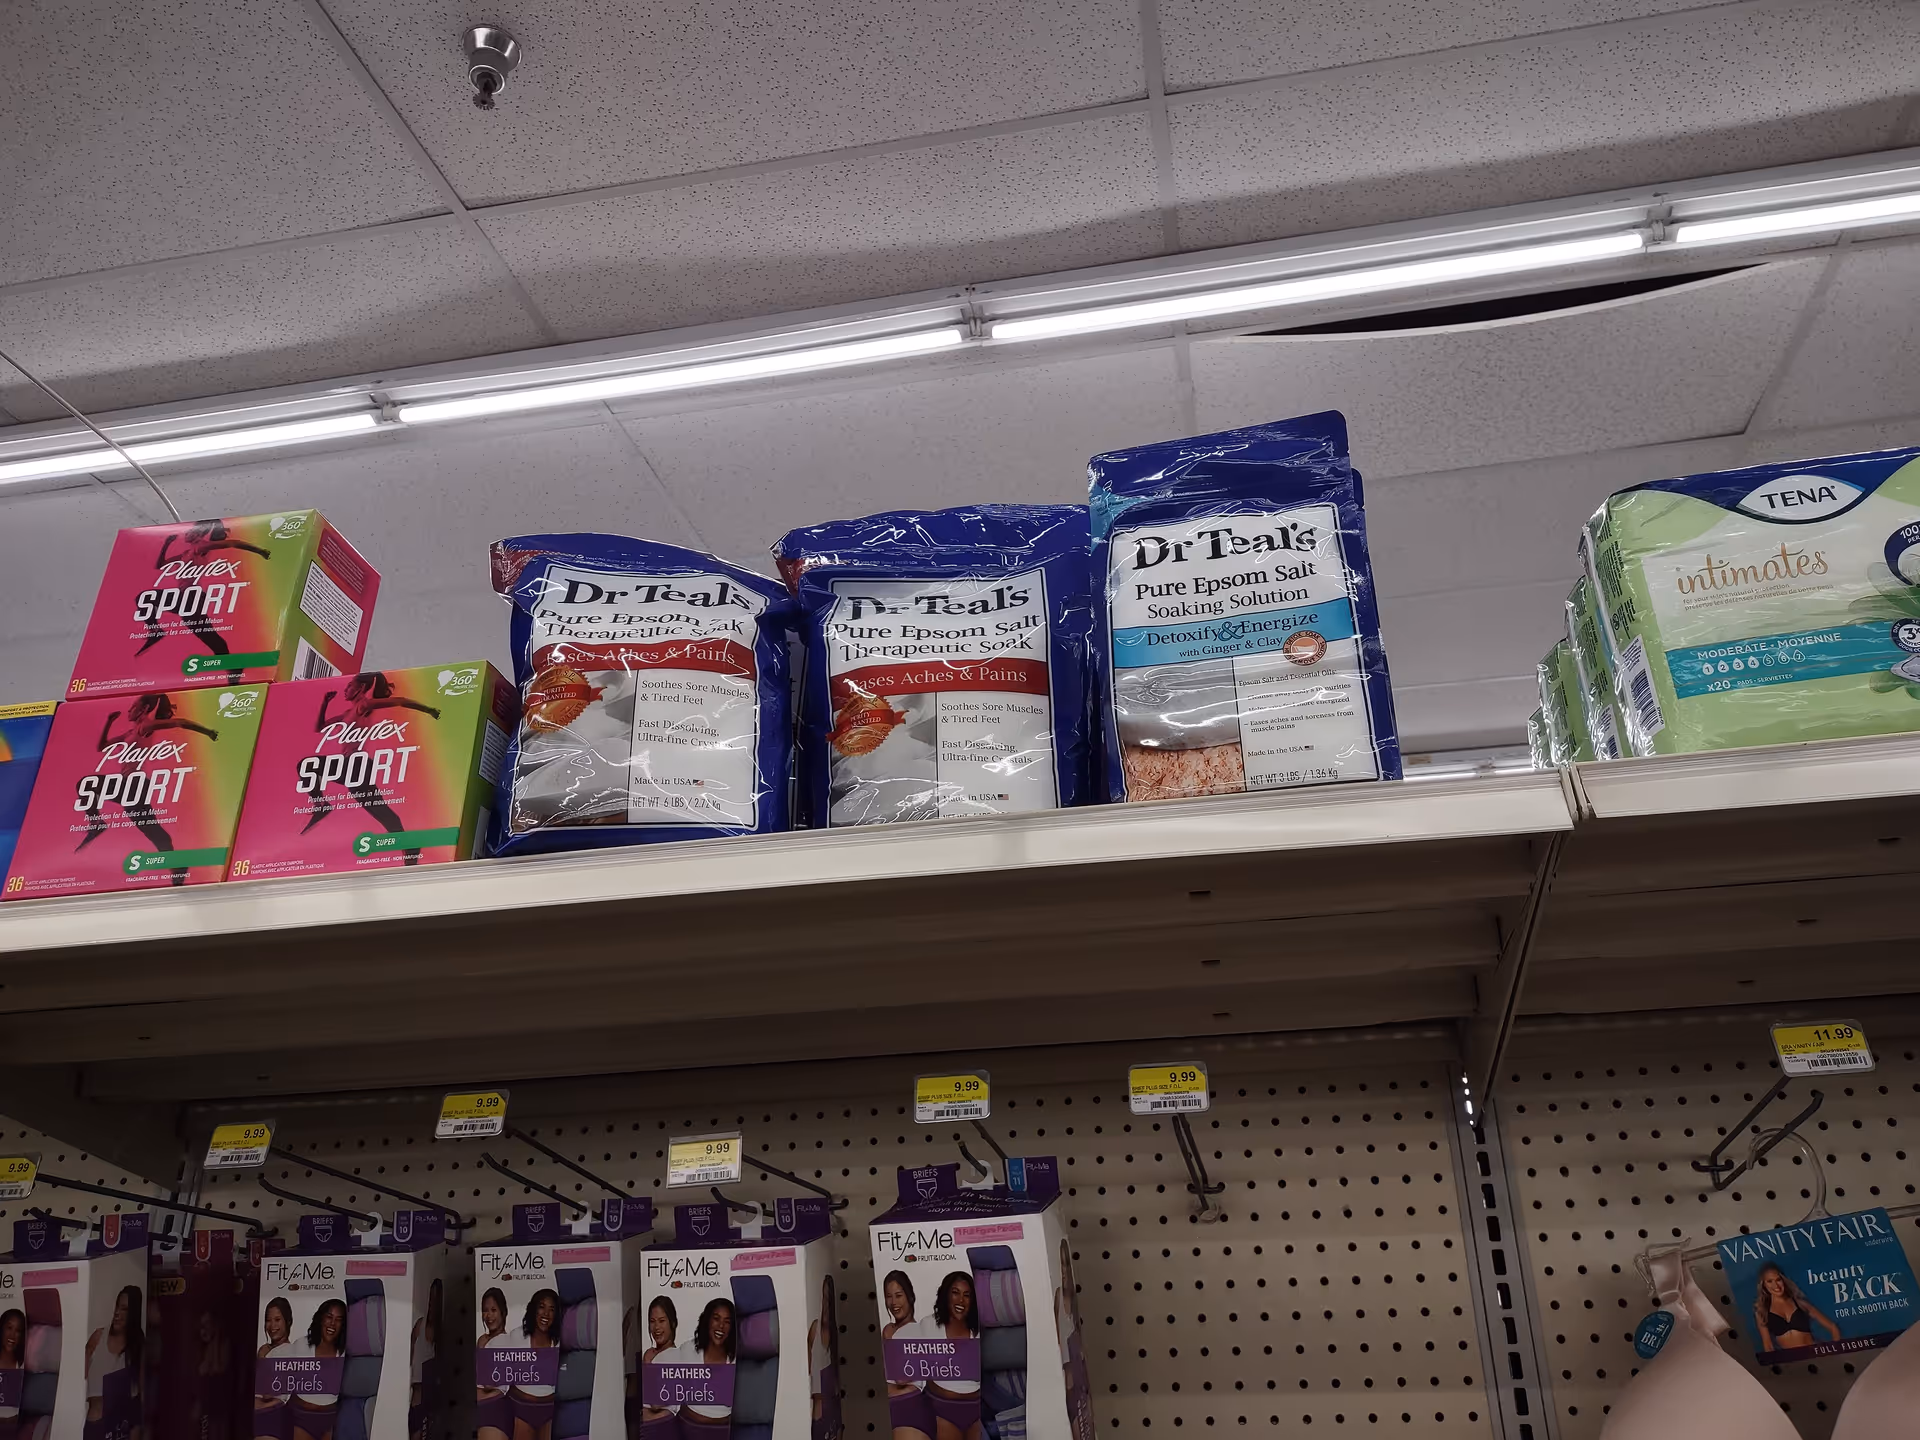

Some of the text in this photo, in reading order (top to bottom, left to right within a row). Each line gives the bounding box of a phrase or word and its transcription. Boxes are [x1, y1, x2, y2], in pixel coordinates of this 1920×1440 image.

[1760, 485, 1838, 510] TENA
[1131, 522, 1318, 570] Dr Teal's
[153, 558, 241, 587] Playtex
[1676, 542, 1829, 594] intimates
[1135, 560, 1317, 600] Pure Epsom Salt
[133, 582, 248, 622] SPORT
[558, 578, 751, 610] Dr Teal's
[846, 585, 1030, 621] Dr Teal's
[1147, 588, 1310, 619] Soaking Solution
[537, 608, 701, 627] Pure Epsom
[544, 619, 744, 641] Therapeutic Soak
[833, 614, 1040, 641] Pure Epsom Salt
[1147, 613, 1319, 646] Detoxify & Energize
[840, 634, 1033, 662] Therapeutic Soak
[1179, 636, 1283, 658] with Ginger & Clay
[1698, 633, 1842, 659] MODERATE MOYENNE
[605, 645, 735, 664] Aches & Pains
[187, 658, 221, 672] S SUPER
[901, 667, 1027, 685] Aches & Pains
[1262, 675, 1275, 684] Salt
[1276, 673, 1289, 682] and
[1707, 674, 1793, 692] x20 SERVIETTES
[71, 679, 87, 692] 36
[543, 686, 566, 694] PURITY
[642, 680, 750, 699] Soothes Sore Muscles
[640, 693, 704, 705] & Tired Feet
[941, 703, 1044, 714] Soothes Sore Muscles
[1337, 710, 1354, 718] from
[951, 715, 978, 723] Tired
[980, 715, 1001, 724] Feet
[638, 720, 720, 737] Fast Dissolving,
[1251, 723, 1296, 733] muscle pains
[315, 719, 409, 754] Playtex
[638, 732, 687, 745] Ultra-fine
[942, 740, 961, 748] Fast
[95, 740, 188, 772] Playtex
[942, 753, 989, 762] Ultra-fine
[296, 746, 417, 793] SPORT
[1250, 768, 1339, 785] NET WT 3 LBS Kg
[74, 766, 193, 811] SPORT
[634, 777, 693, 785] Made USA
[307, 794, 336, 804] Protection
[346, 791, 366, 799] Bodies
[373, 788, 394, 796] Motion
[372, 797, 406, 806] mouvement
[632, 797, 684, 808] NET 6 LBS
[358, 837, 396, 852] S SUPER
[129, 855, 165, 871] S SUPER
[232, 860, 250, 876] 36
[7, 876, 24, 892] 36
[1814, 1027, 1854, 1040] 11.99
[1170, 1071, 1196, 1082] 9.99
[954, 1080, 979, 1092] 9.99
[476, 1097, 499, 1108] 9.99
[243, 1128, 265, 1138] 9.99
[706, 1142, 730, 1154] 9.99
[8, 1163, 30, 1173] 9.99
[912, 1168, 938, 1179] BRIEFS
[1013, 1177, 1021, 1186] 11
[525, 1206, 546, 1214] BRIEFS
[688, 1206, 712, 1215] BRIEFS
[27, 1222, 47, 1230] BRIEFS
[312, 1217, 334, 1225] BRIEFS
[609, 1215, 618, 1223] 10
[781, 1215, 790, 1223] 10
[399, 1226, 408, 1234] 10
[878, 1229, 953, 1252] Fit Me
[1722, 1214, 1885, 1263] VANITY FAIR
[1864, 1236, 1894, 1246] underwire
[481, 1252, 544, 1271] Fit Me
[647, 1256, 718, 1277] Fit Me
[266, 1262, 334, 1280] Fit Me
[1807, 1264, 1866, 1285] beauty
[1832, 1272, 1902, 1304] BACK
[1835, 1298, 1909, 1318] FOR A SMOOTH BACK
[904, 1343, 955, 1354] HEATHERS
[1814, 1338, 1876, 1355] FULL FIGURE
[493, 1352, 537, 1362] HEATHERS
[274, 1361, 321, 1372] HEATHERS
[492, 1365, 540, 1382] 6 Briefs
[661, 1368, 711, 1379] HEATHERS
[903, 1359, 961, 1378] 6 Briefs
[272, 1374, 323, 1392] 6 Briefs
[659, 1383, 715, 1402] 6 Briefs
